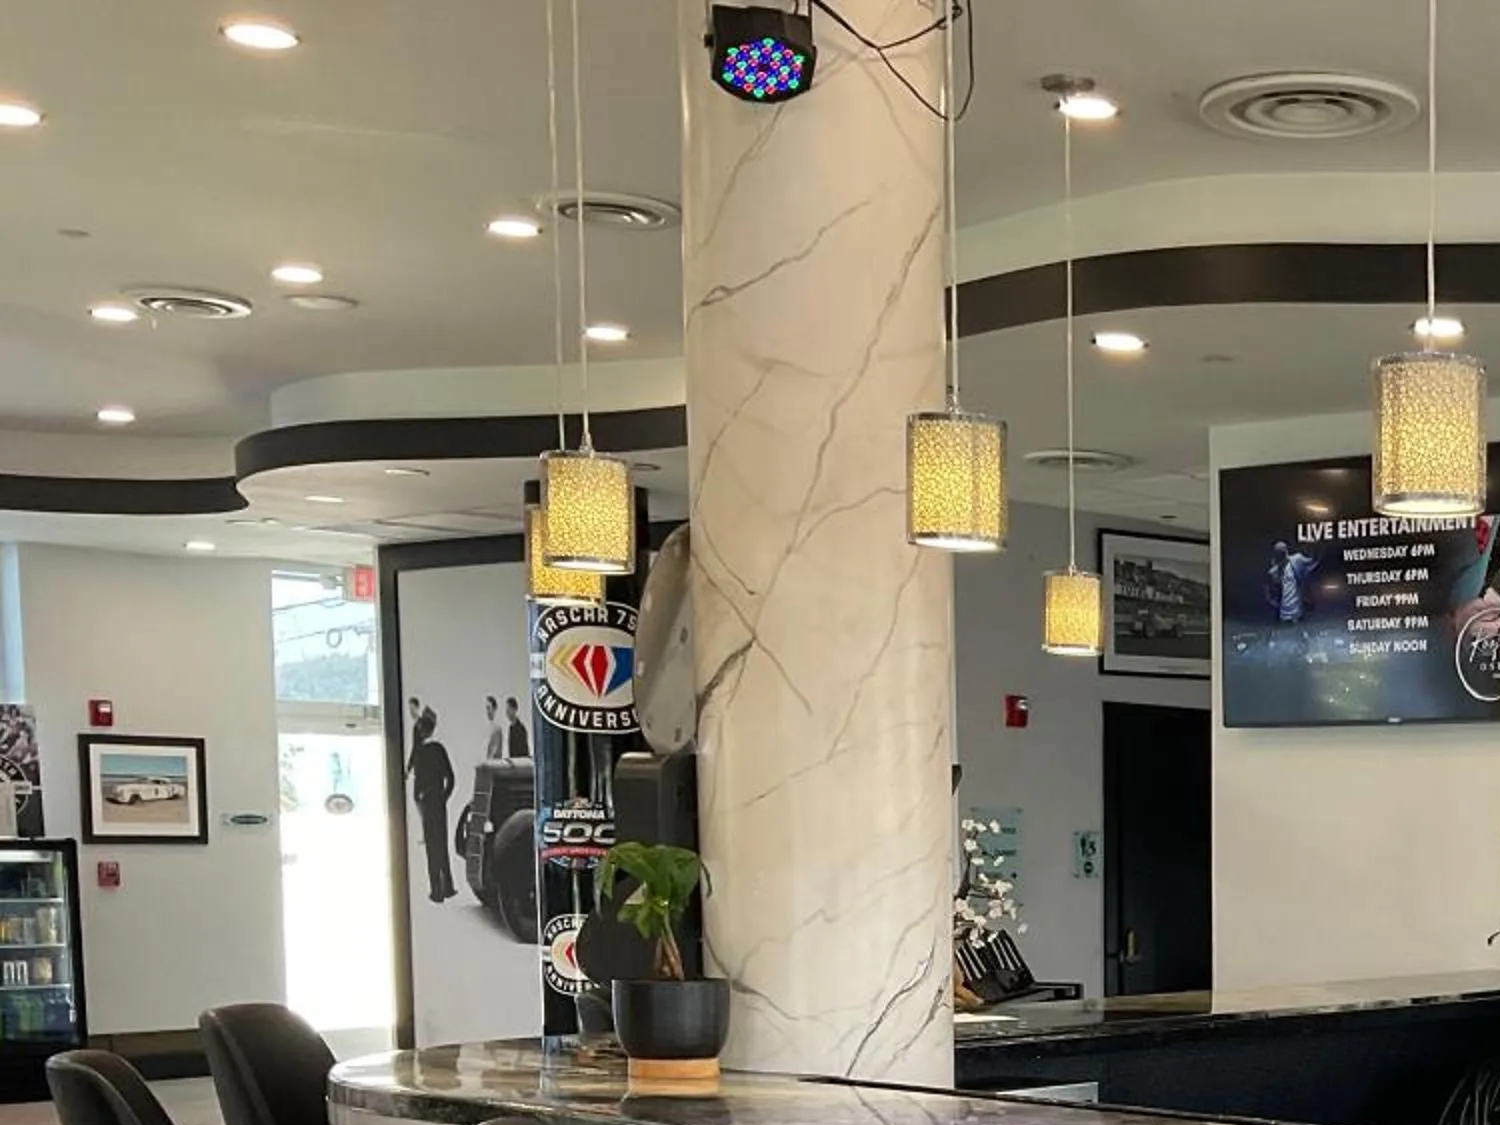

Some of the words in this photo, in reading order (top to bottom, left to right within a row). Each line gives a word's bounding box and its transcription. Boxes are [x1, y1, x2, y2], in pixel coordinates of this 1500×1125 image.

[1297, 522, 1333, 542] LIVE
[1337, 516, 1476, 539] ENTERTAINMENT
[1343, 546, 1408, 561] WEDNESDAY
[1411, 543, 1435, 557] 6PM
[1346, 569, 1402, 584] THURSDAY
[1356, 594, 1392, 608] FRIDAY
[1347, 617, 1401, 631] SATURDAY
[1349, 641, 1391, 655] SUNDAY
[1393, 639, 1427, 653] NOON
[553, 809, 605, 819] DAYTONA
